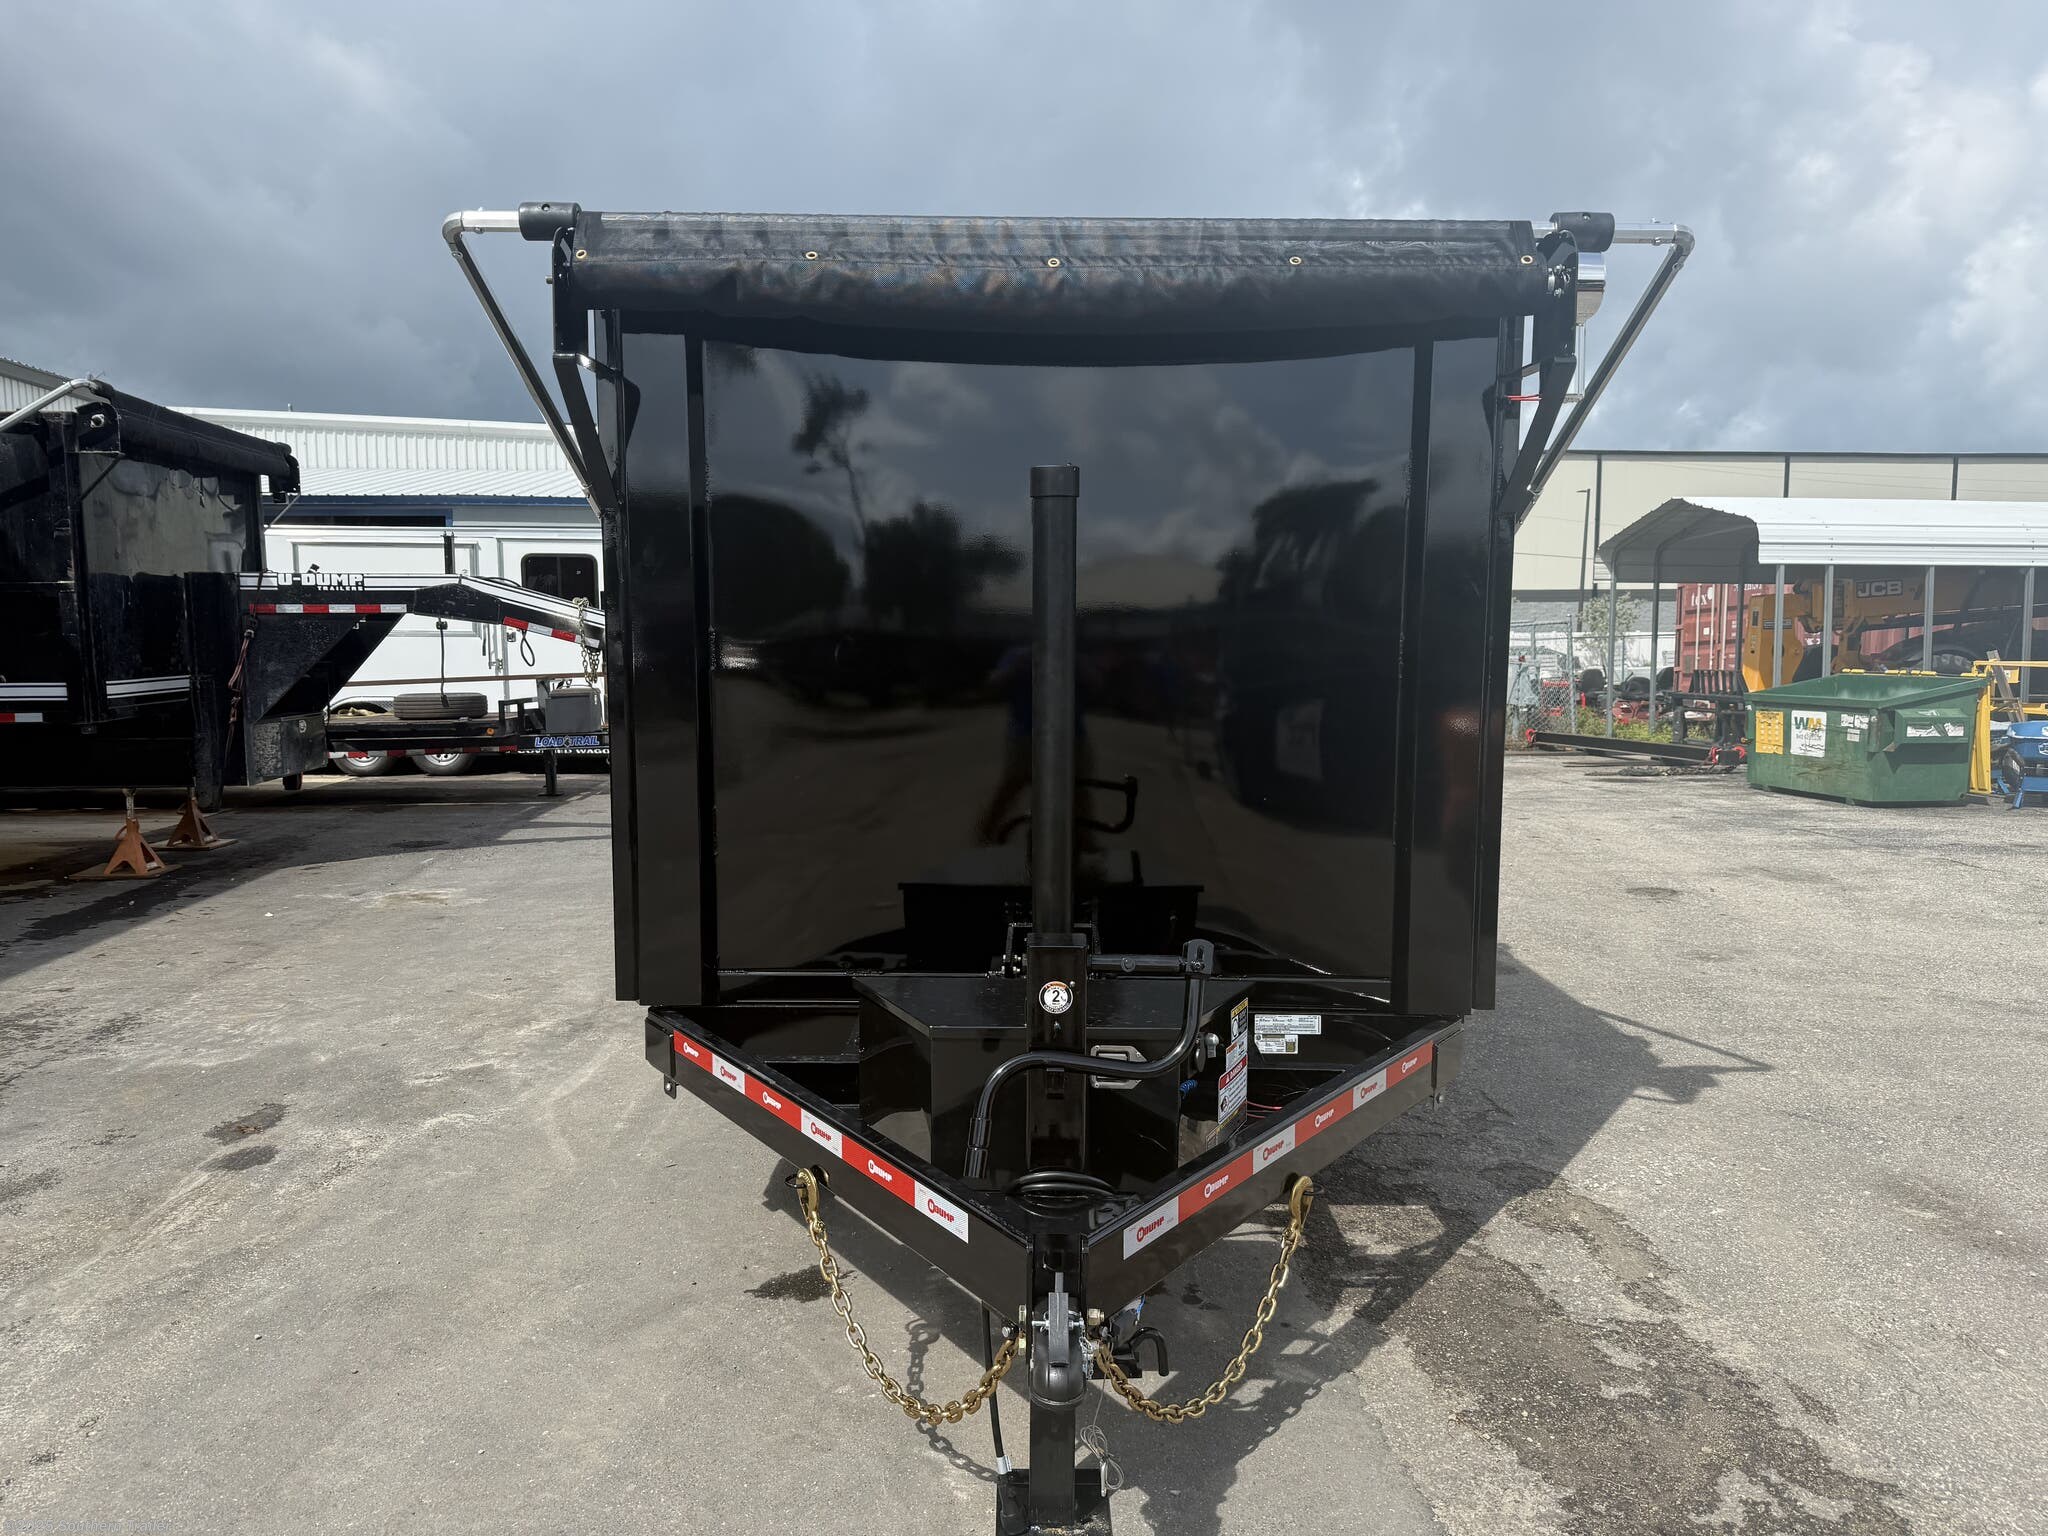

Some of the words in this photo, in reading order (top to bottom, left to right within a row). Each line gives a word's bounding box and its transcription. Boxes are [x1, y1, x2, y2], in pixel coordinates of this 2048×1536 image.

[1857, 581, 1902, 597] JCB
[1794, 716, 1822, 731] WM
[535, 736, 563, 747] LOAD
[569, 736, 600, 746] TRAIL
